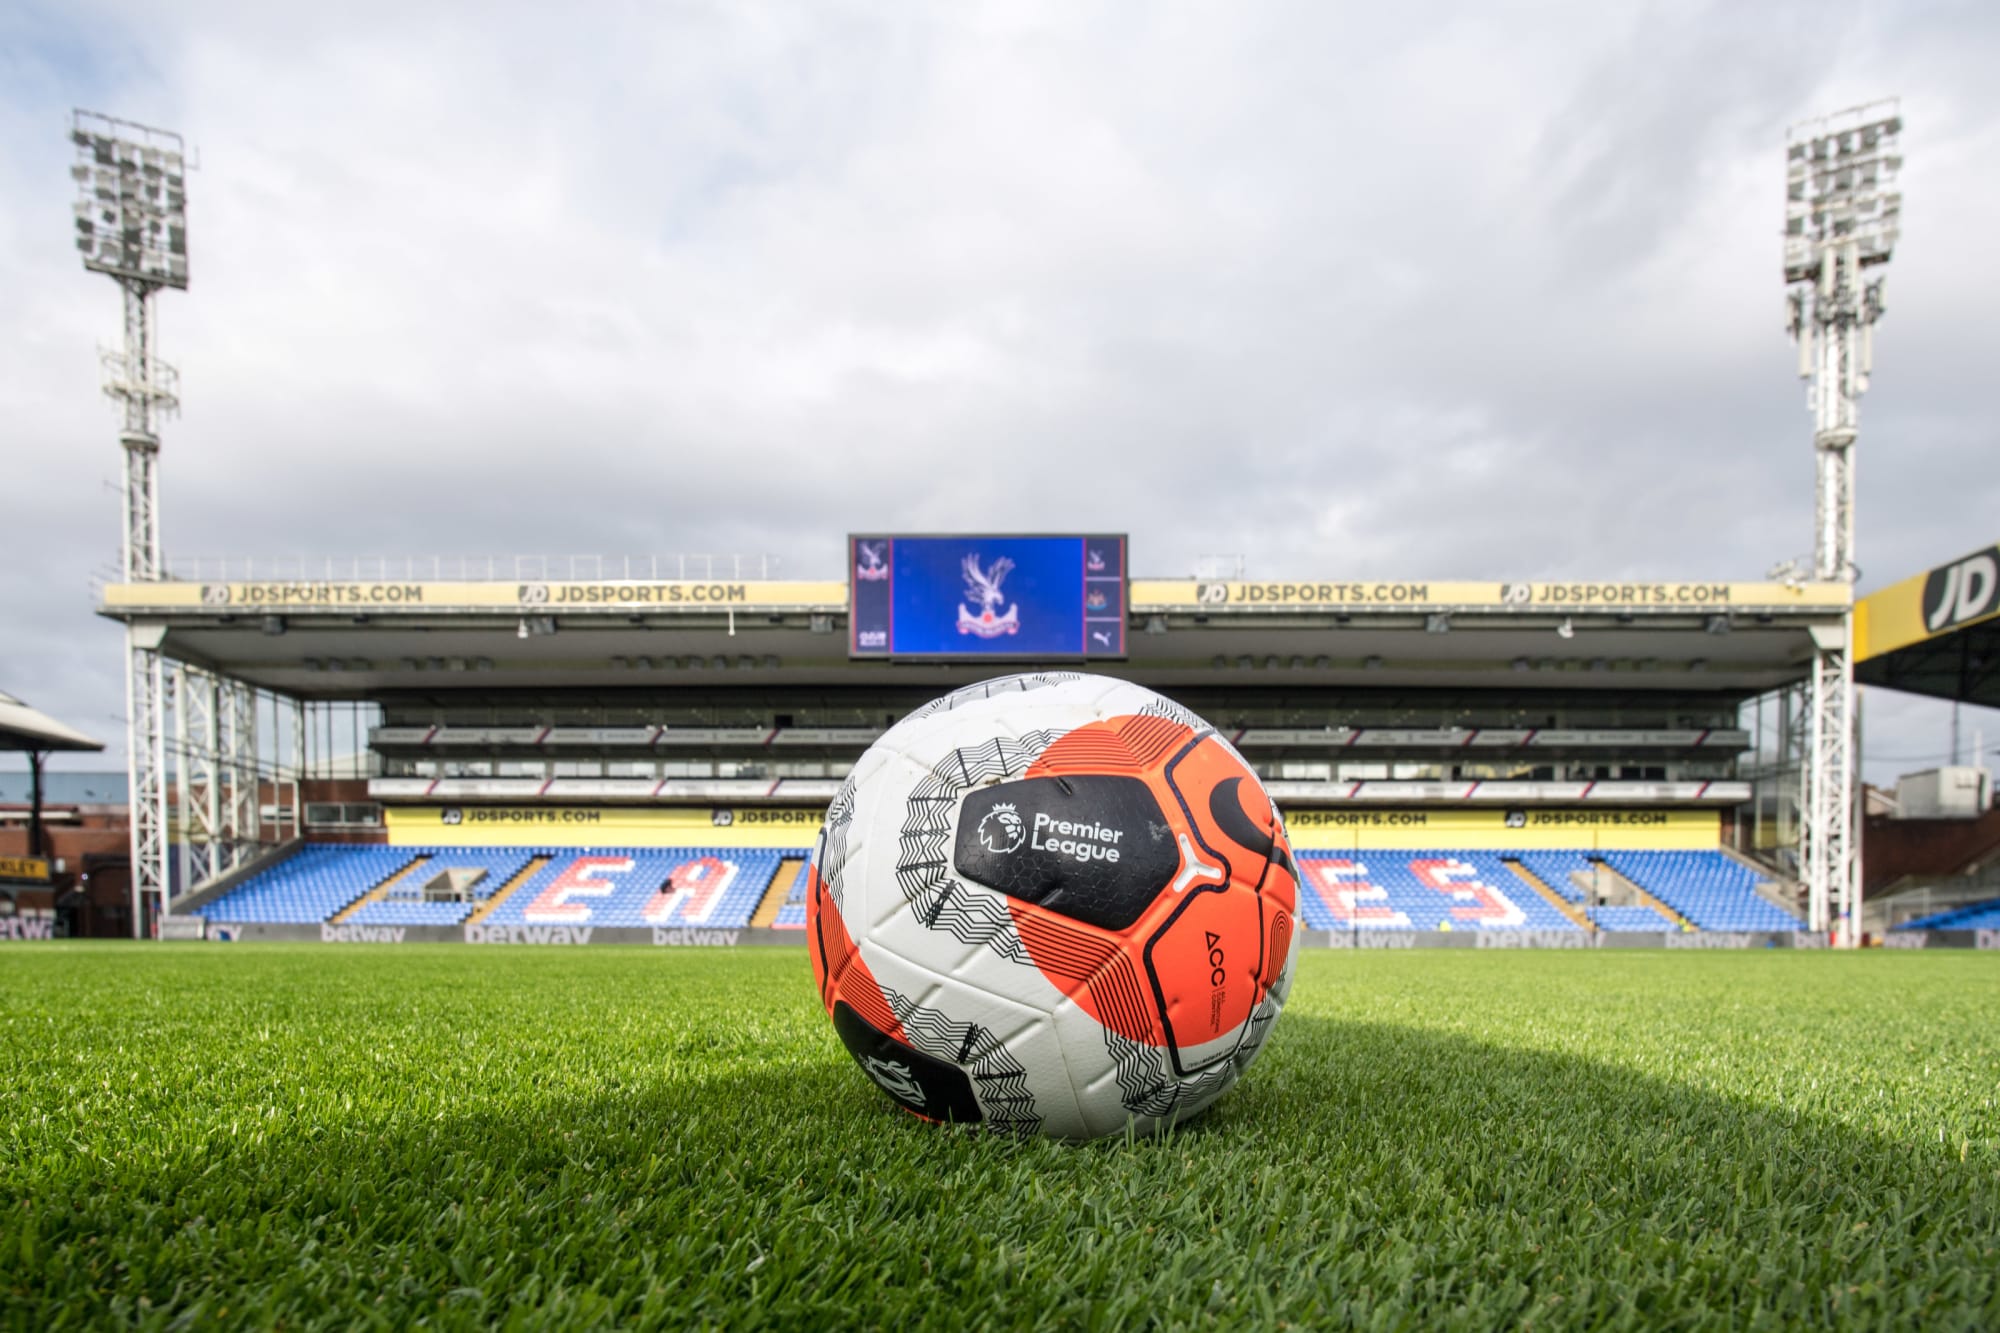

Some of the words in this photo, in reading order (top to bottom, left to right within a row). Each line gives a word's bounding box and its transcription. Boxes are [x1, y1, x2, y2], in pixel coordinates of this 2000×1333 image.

[239, 584, 423, 603] JDSPORTS.COM
[556, 584, 746, 603] JDSPORTS.COM
[1235, 584, 1428, 602] JDSPORTS.COM
[1539, 585, 1730, 603] JDSPORTS.COM
[1929, 555, 1997, 630] JD
[468, 810, 600, 823] JDSPORTS.COM
[1291, 812, 1427, 825] JDSPORTS.COM
[1533, 812, 1667, 825] JDSPORTS.COM
[1033, 812, 1123, 844] Premier
[1031, 831, 1120, 863] League
[320, 922, 405, 942] betway
[652, 926, 739, 946] betway
